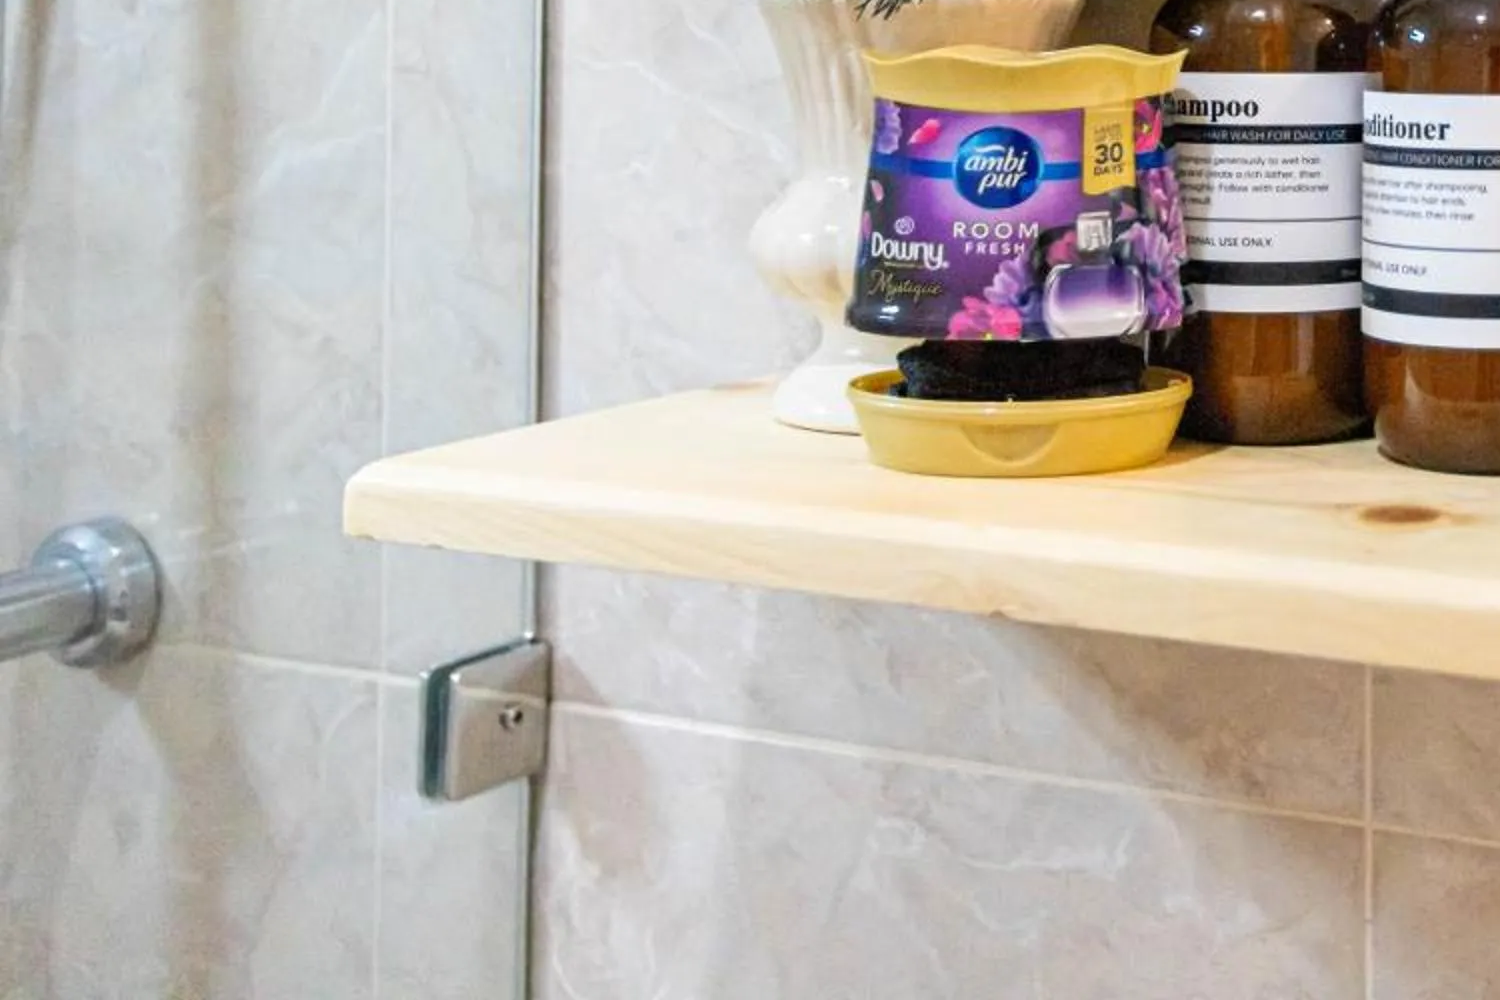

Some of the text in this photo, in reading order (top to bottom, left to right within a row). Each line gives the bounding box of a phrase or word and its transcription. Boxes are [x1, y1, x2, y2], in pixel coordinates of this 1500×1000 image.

[1171, 99, 1259, 122] ampoo
[1229, 129, 1265, 141] WASH
[1268, 130, 1291, 141] FOR
[1294, 129, 1323, 141] DAILY
[1326, 129, 1346, 140] USE
[963, 146, 1029, 172] ambi
[1094, 142, 1123, 164] 30
[1400, 152, 1475, 168] CONDITIONER
[1093, 163, 1124, 175] DAYS
[977, 171, 1028, 195] pur
[953, 222, 1039, 239] ROOM
[965, 242, 1025, 255] FRESH
[1218, 236, 1237, 247] USE
[871, 232, 944, 270] Downy
